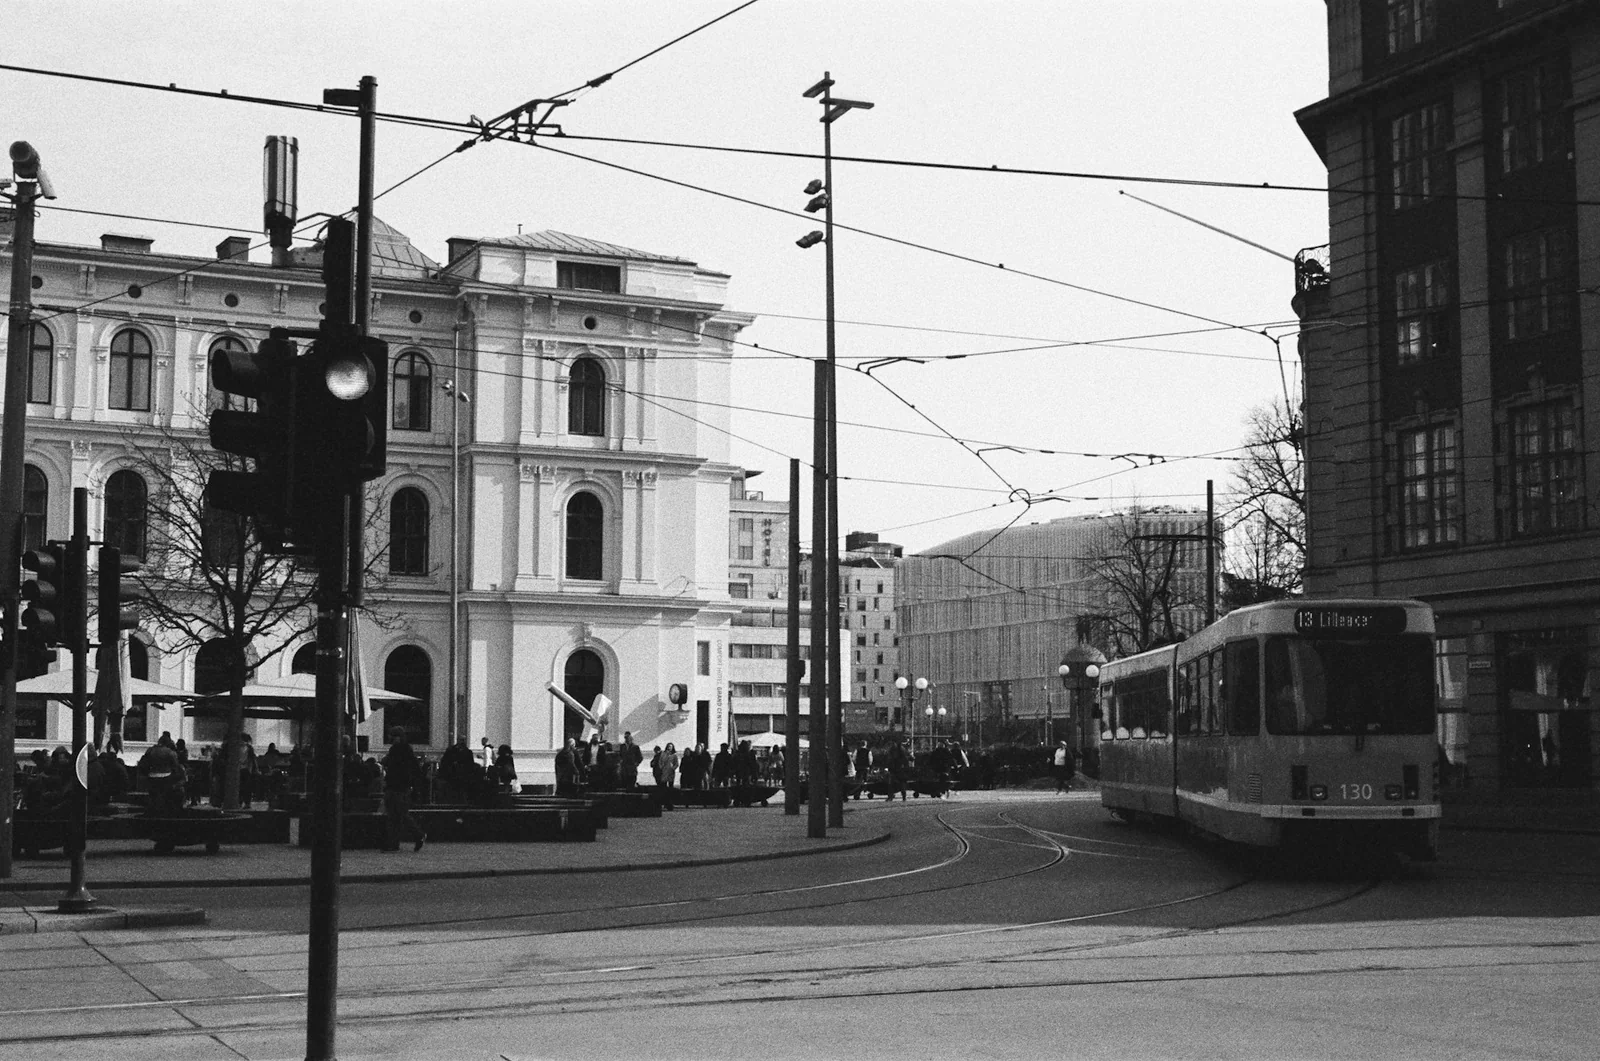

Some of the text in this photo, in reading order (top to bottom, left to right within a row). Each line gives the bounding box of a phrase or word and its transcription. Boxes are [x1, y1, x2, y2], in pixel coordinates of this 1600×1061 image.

[763, 518, 772, 567] HOTEL
[1298, 611, 1373, 627] 13 Lilleae
[1340, 783, 1373, 800] 130
